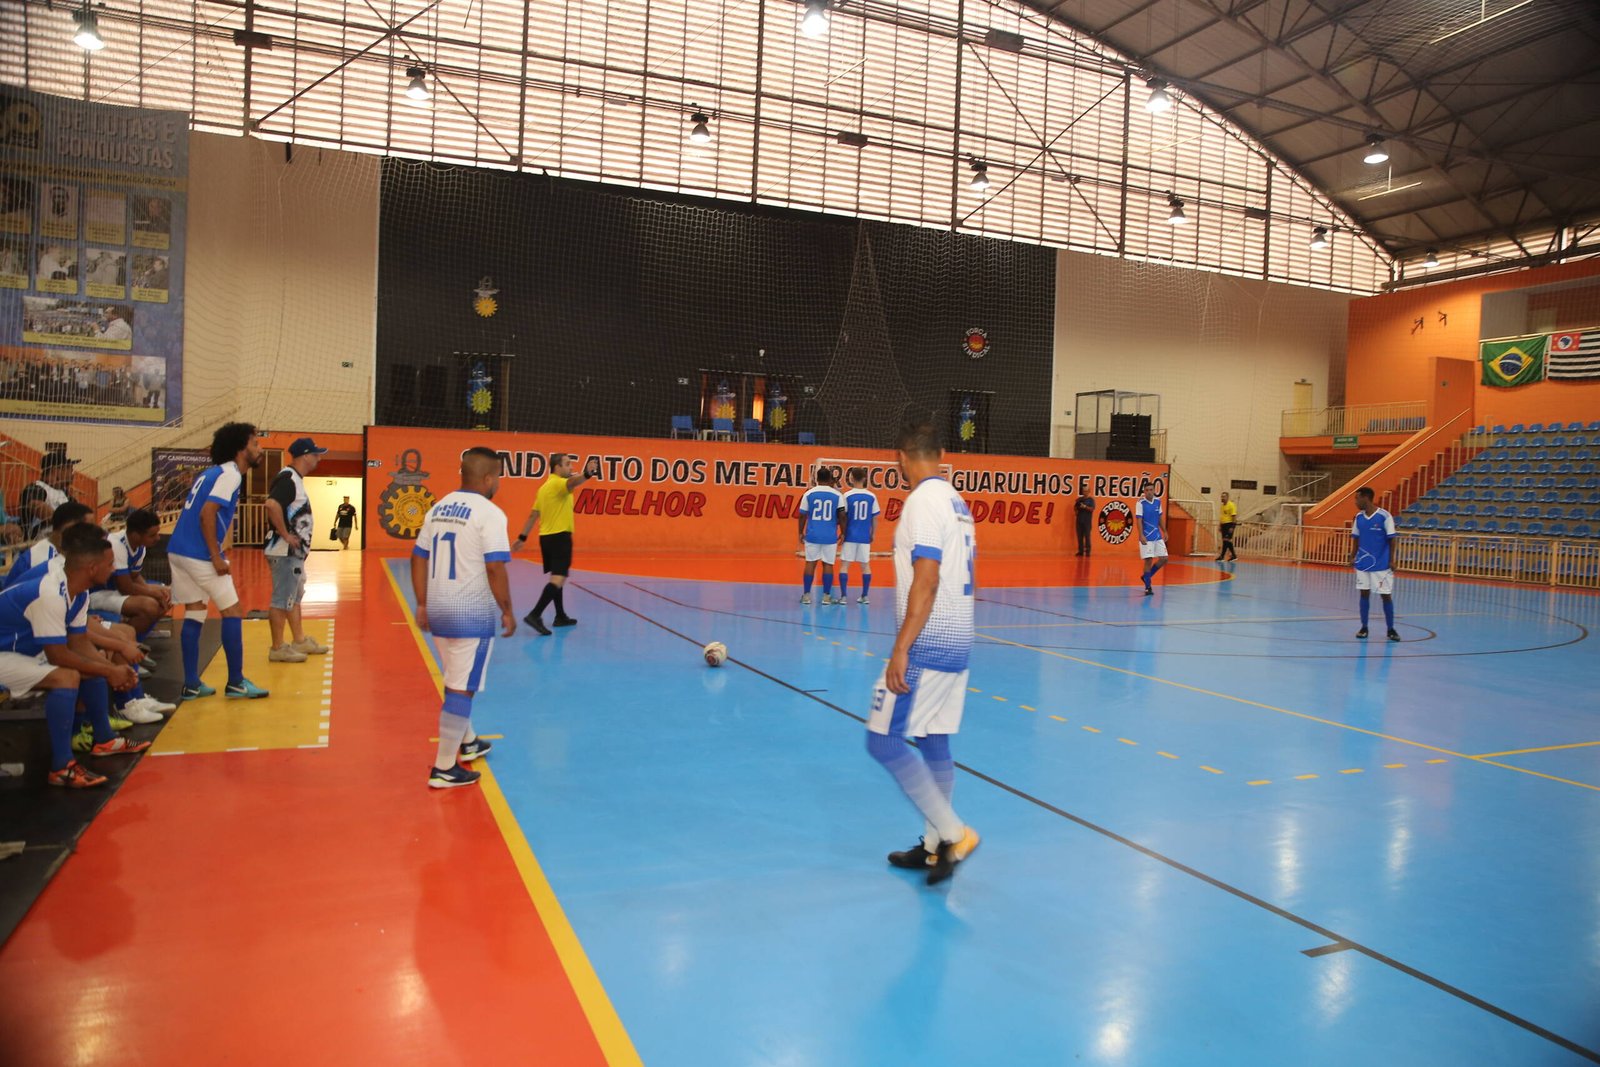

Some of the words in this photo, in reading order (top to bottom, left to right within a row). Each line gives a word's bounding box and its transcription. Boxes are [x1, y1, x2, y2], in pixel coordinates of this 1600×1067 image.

[95, 113, 157, 142] LUTAS
[164, 120, 177, 145] E
[57, 134, 175, 170] CONQUISTAS
[184, 474, 207, 510] 9
[651, 457, 707, 484] DOS
[951, 469, 1073, 496] GUARULHOS
[573, 488, 707, 518] MELHOR
[812, 498, 834, 521] 20
[853, 500, 870, 521] 10
[1098, 523, 1133, 544] SINDICAL
